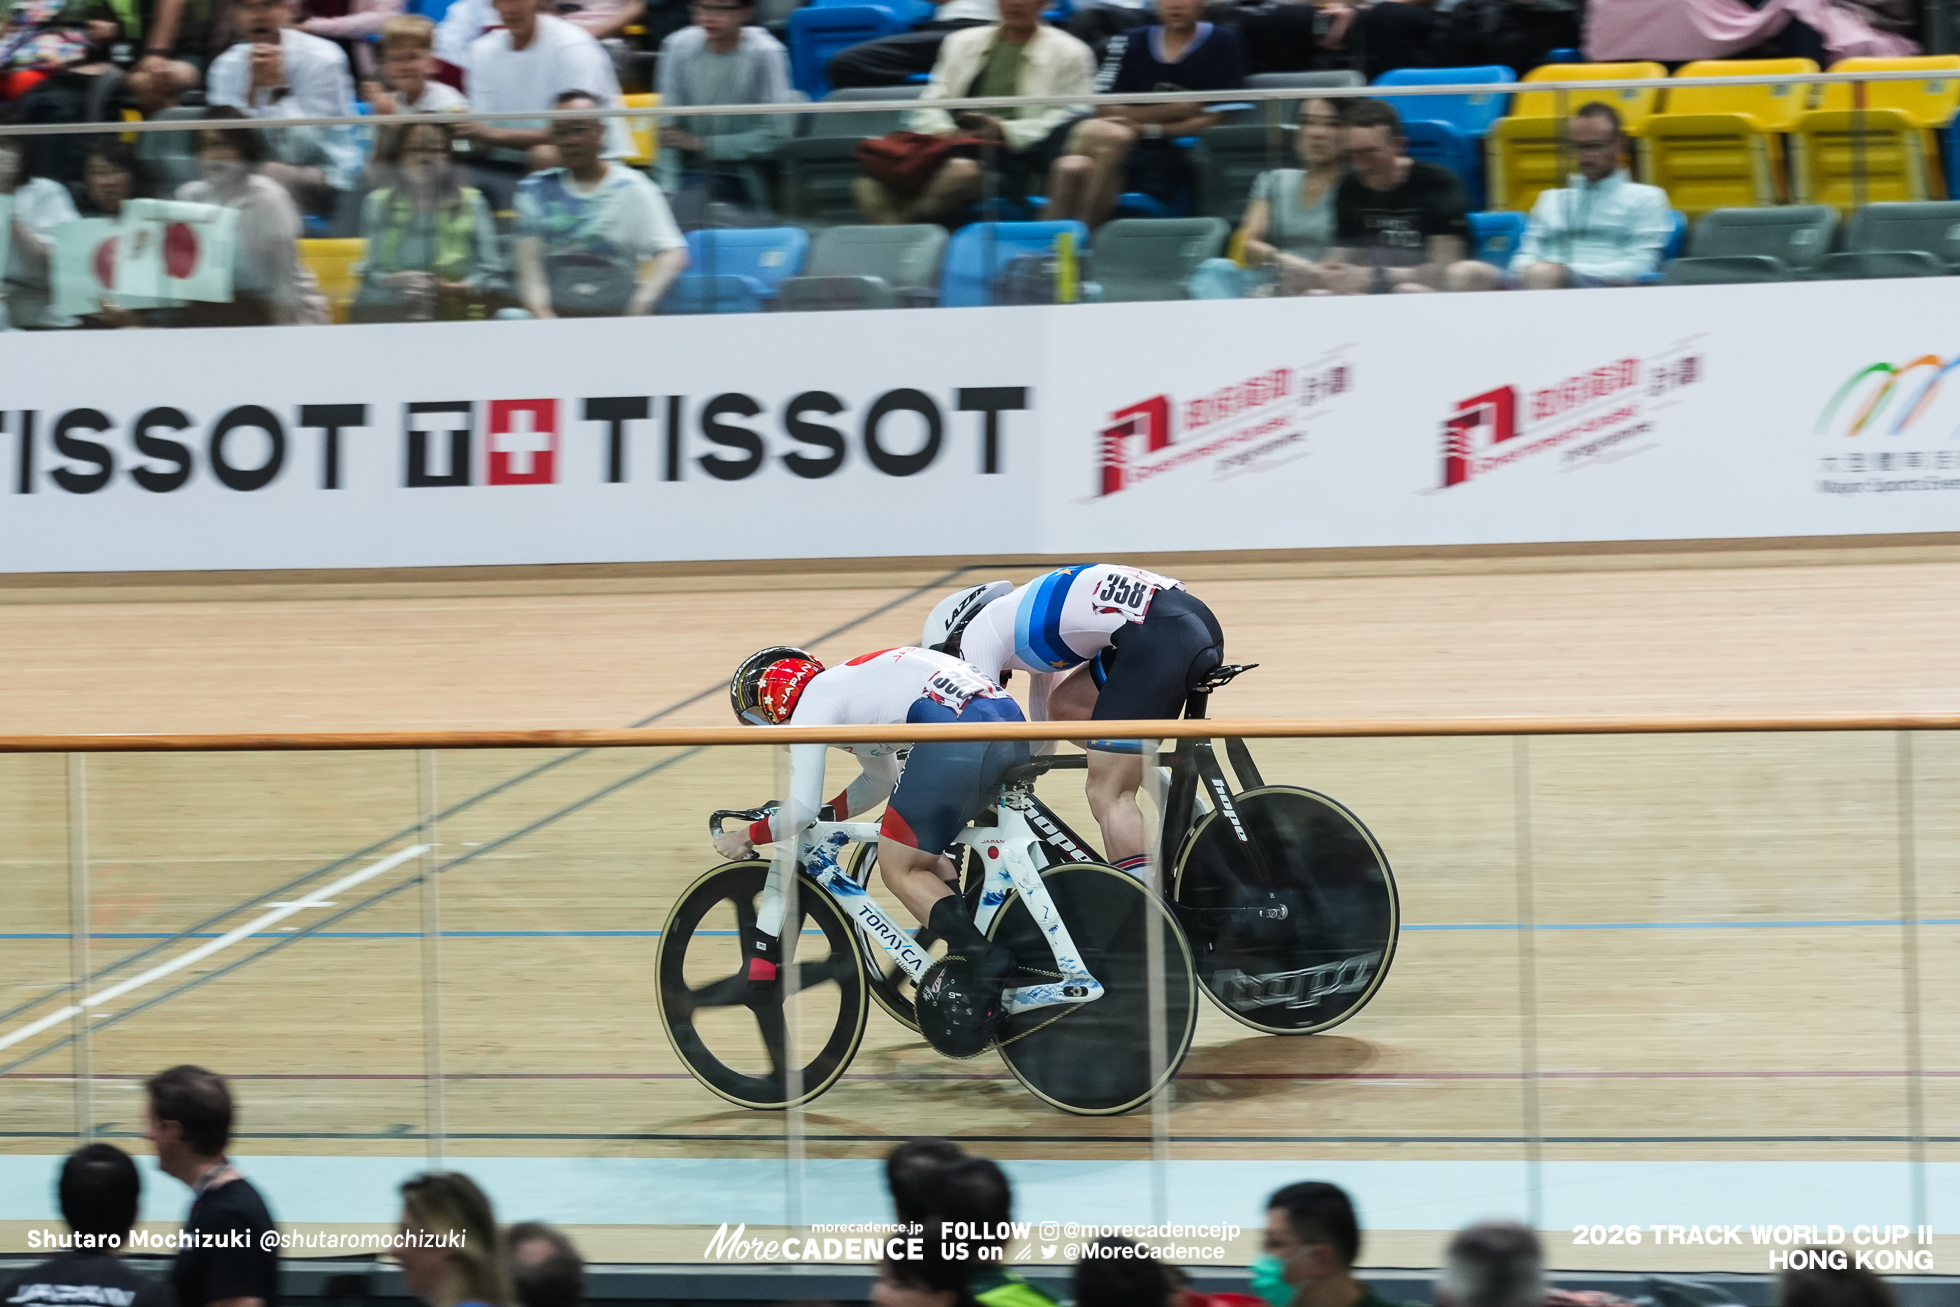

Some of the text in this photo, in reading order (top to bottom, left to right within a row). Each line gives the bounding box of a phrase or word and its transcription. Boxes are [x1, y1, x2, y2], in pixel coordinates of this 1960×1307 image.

[0, 404, 373, 494] ISSOT
[578, 386, 1034, 483] TISSOT
[944, 585, 988, 631] LAZER
[1099, 573, 1147, 609] 358
[782, 663, 812, 704] JAPAN
[1212, 779, 1248, 842] hope
[858, 905, 922, 971] TORAYCA
